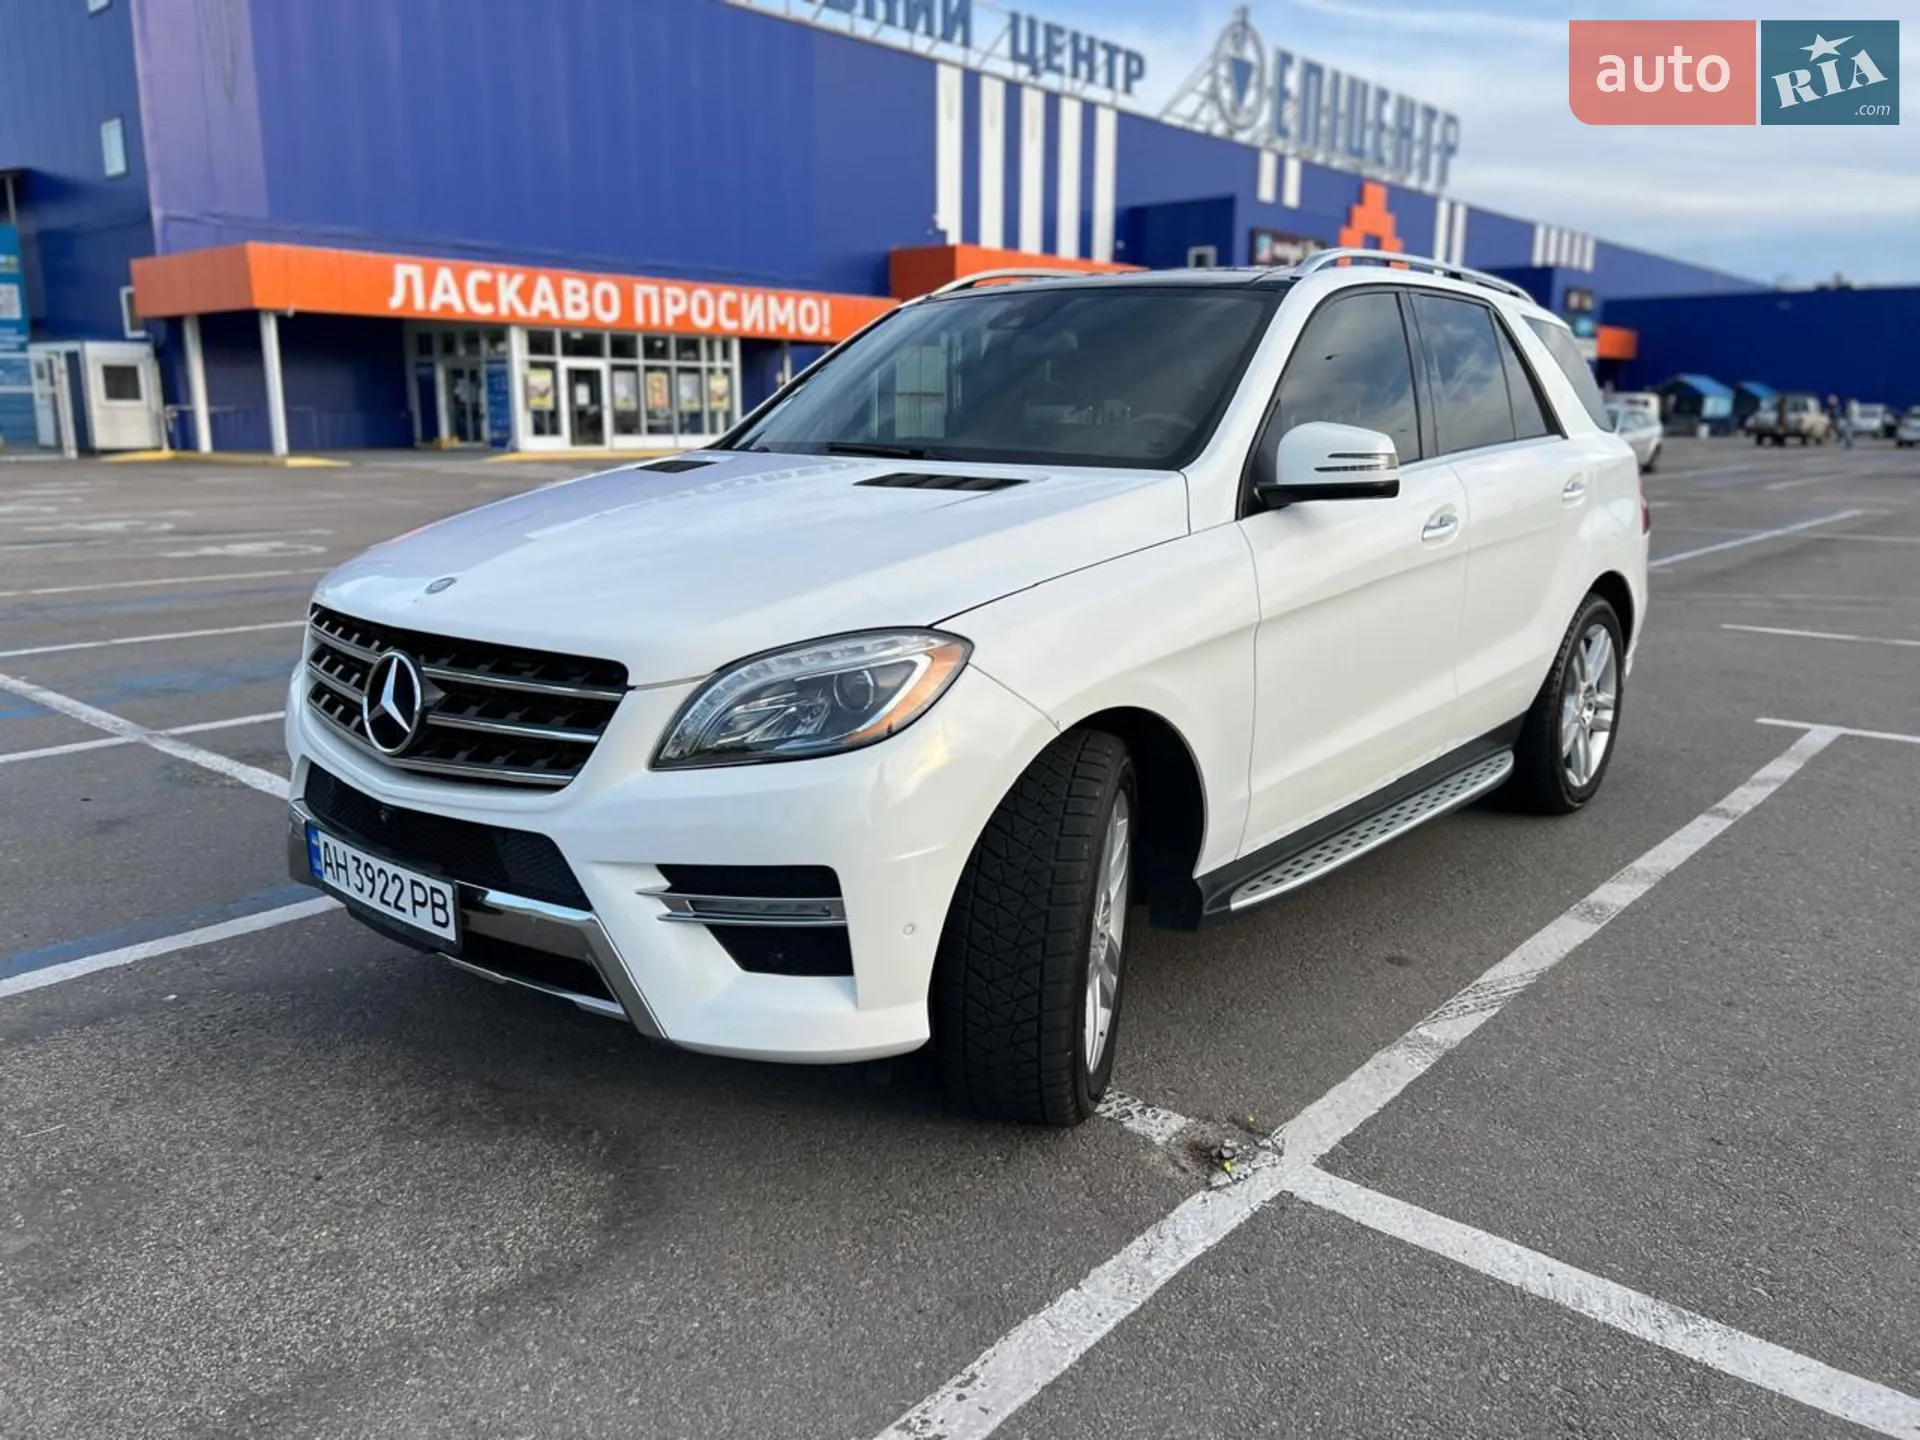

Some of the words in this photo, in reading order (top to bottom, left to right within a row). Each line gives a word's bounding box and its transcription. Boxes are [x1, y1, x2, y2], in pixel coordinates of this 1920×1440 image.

[1009, 11, 1145, 94] ЦЕНТР
[1272, 46, 1460, 190] ЕПІЦЕНТР
[389, 262, 622, 323] ЛАСКАВО
[634, 284, 831, 337] ПРОСИМО!
